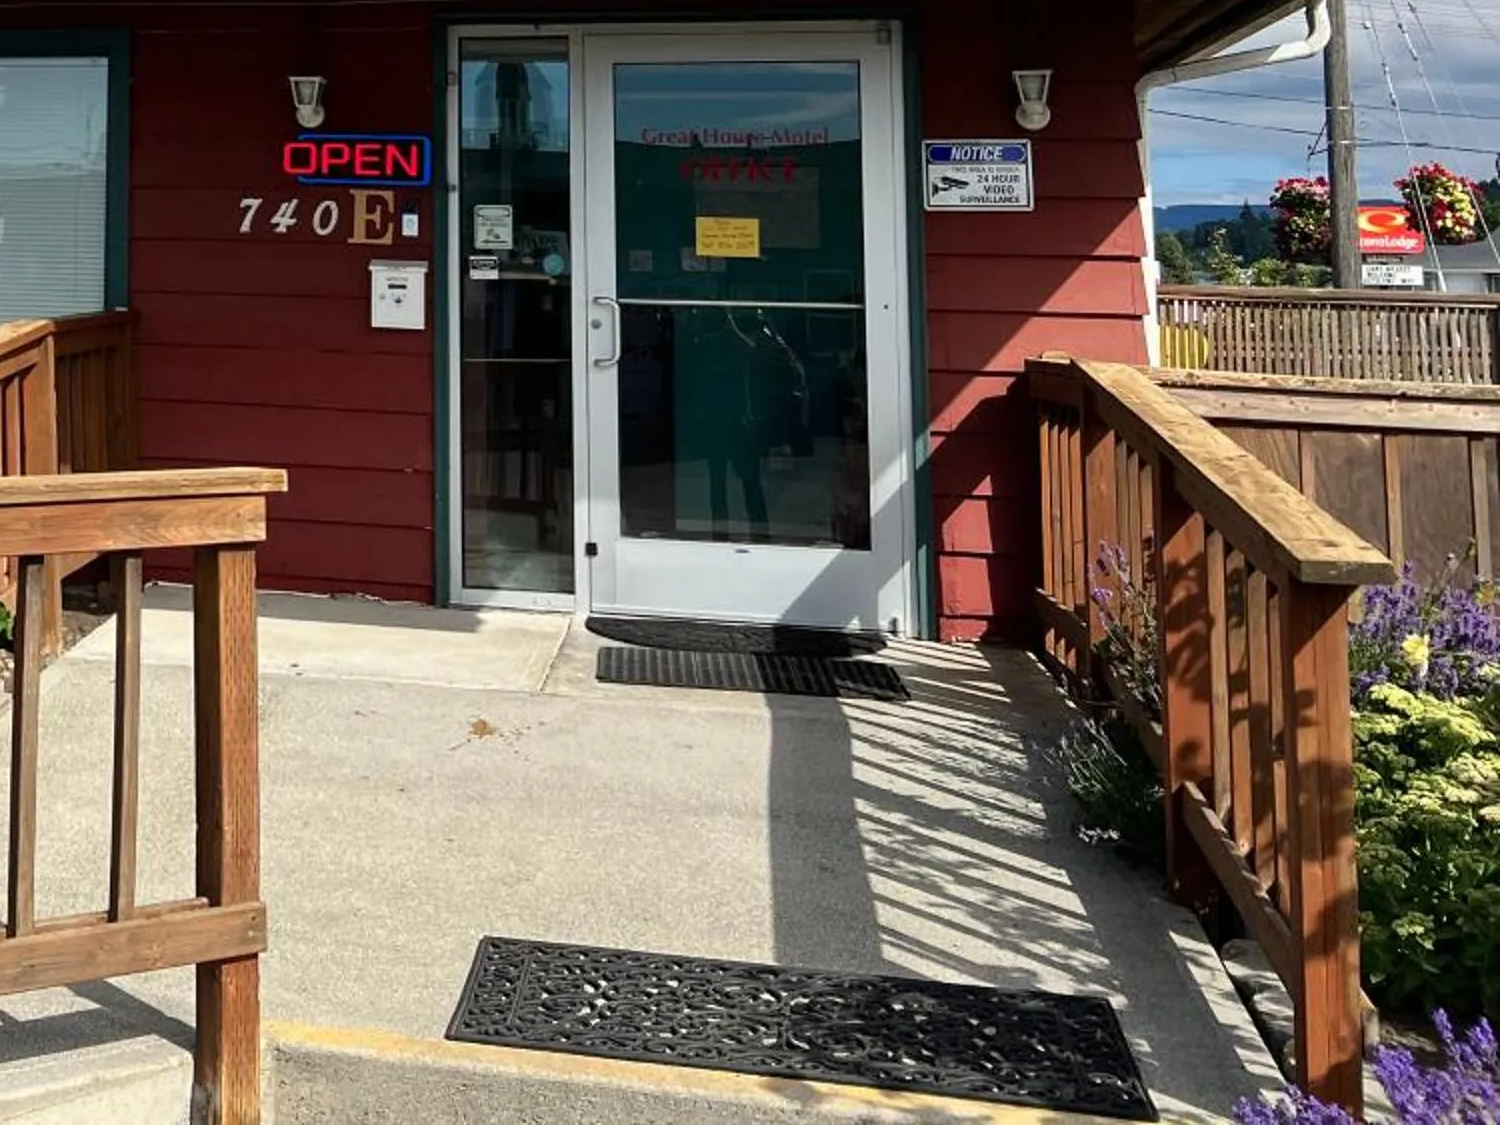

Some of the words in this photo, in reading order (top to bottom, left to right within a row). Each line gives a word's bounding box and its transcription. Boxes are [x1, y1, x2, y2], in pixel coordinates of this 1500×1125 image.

[641, 128, 700, 144] Great
[770, 127, 830, 144] Motel
[283, 142, 419, 177] OPEN
[949, 146, 1004, 161] NOTICE
[976, 175, 989, 184] 24
[991, 175, 1021, 184] HOUR
[983, 185, 1016, 195] VIDEO
